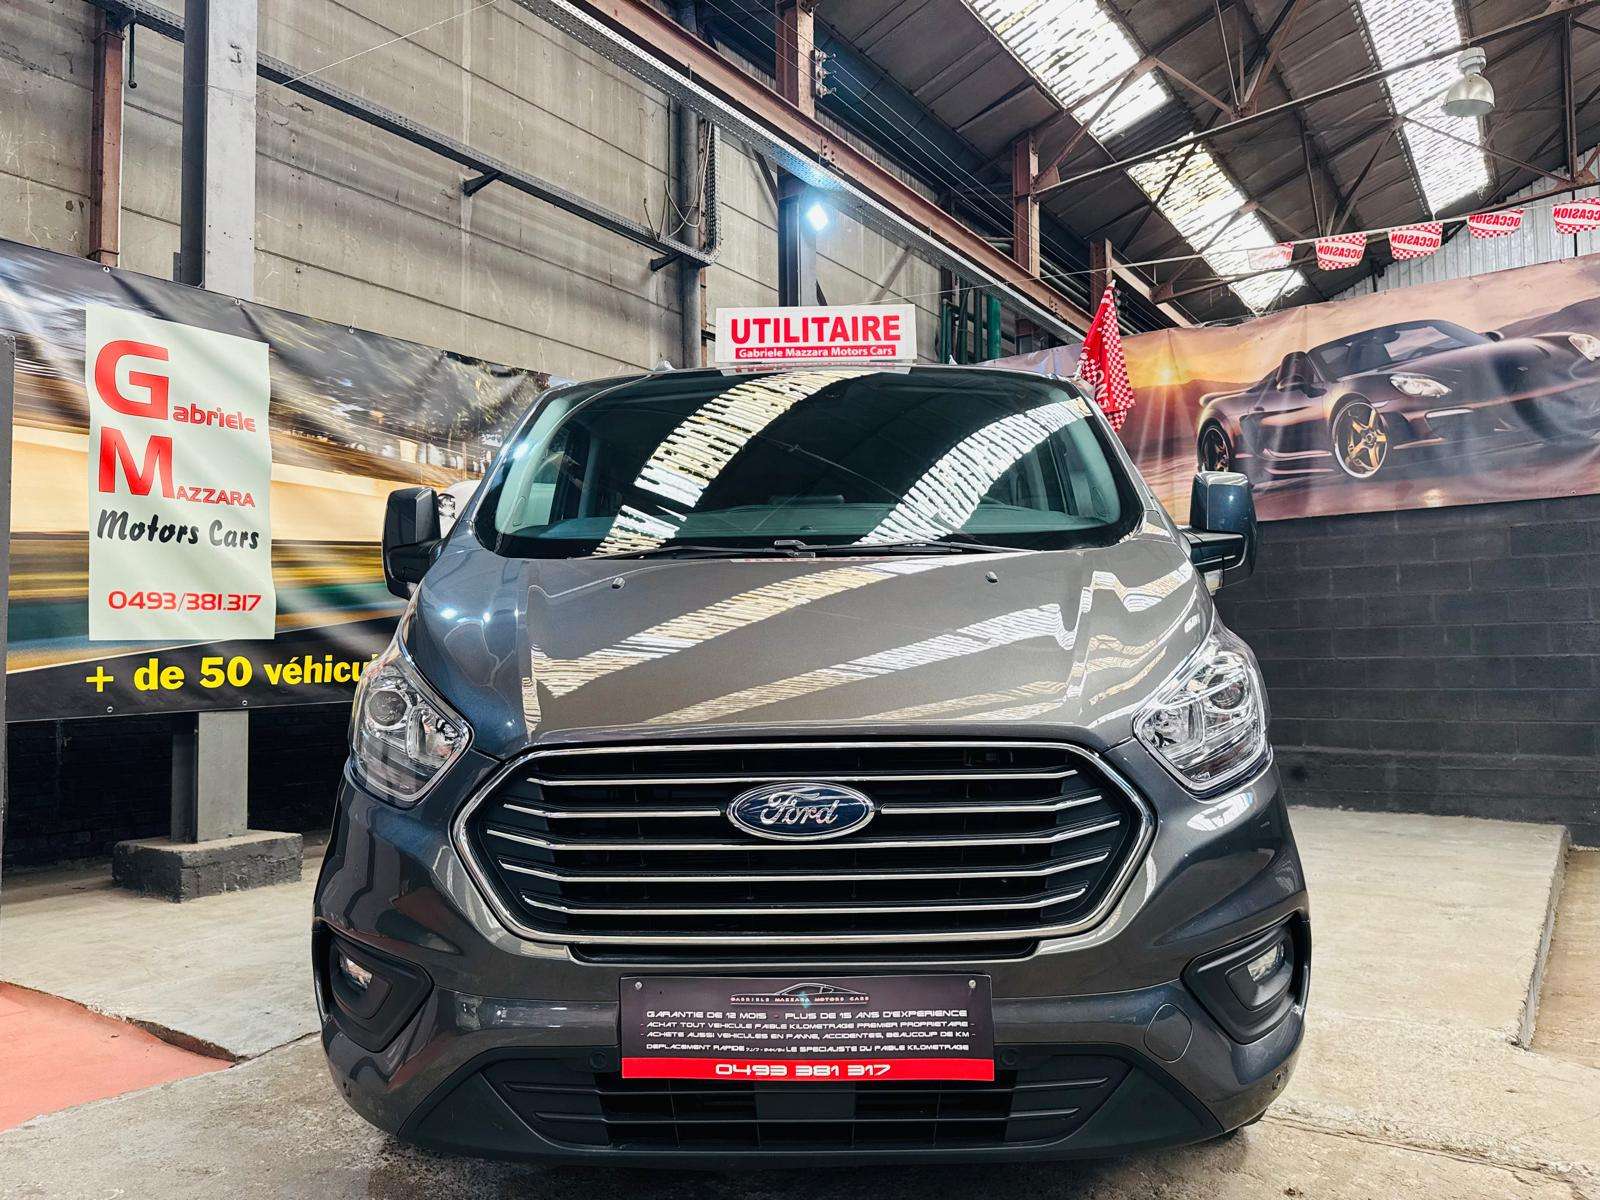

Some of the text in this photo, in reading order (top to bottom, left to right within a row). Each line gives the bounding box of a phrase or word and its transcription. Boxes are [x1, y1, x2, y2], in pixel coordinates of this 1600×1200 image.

[731, 315, 901, 344] UTILITAIRE
[738, 346, 894, 359] Gabriele Mazzara Motors Cars
[95, 340, 256, 433] Gabriele
[98, 426, 256, 508] MAZZARA
[96, 508, 260, 550] Motors Cars
[107, 590, 262, 613] 0493/381.317
[134, 657, 185, 692] de
[200, 656, 253, 689] 50
[263, 652, 379, 685] véhicu
[759, 791, 840, 825] Ford
[646, 1010, 704, 1019] GARANTIE
[706, 1011, 723, 1019] DE
[739, 1012, 767, 1020] MOIS
[784, 1012, 817, 1020] PLUS
[820, 1012, 837, 1020] DE
[839, 1011, 852, 1019] 15
[855, 1010, 880, 1019] ANS
[883, 1009, 968, 1018] D'EXPERIENCE
[789, 1022, 855, 1030] KILOMETRAGE
[646, 1043, 712, 1051] DEPLACEMENT
[713, 1044, 745, 1052] RAPIDE
[786, 1045, 798, 1053] LE
[799, 1045, 858, 1053] SPECIALISTE
[715, 1063, 892, 1077] 0493 381 317
